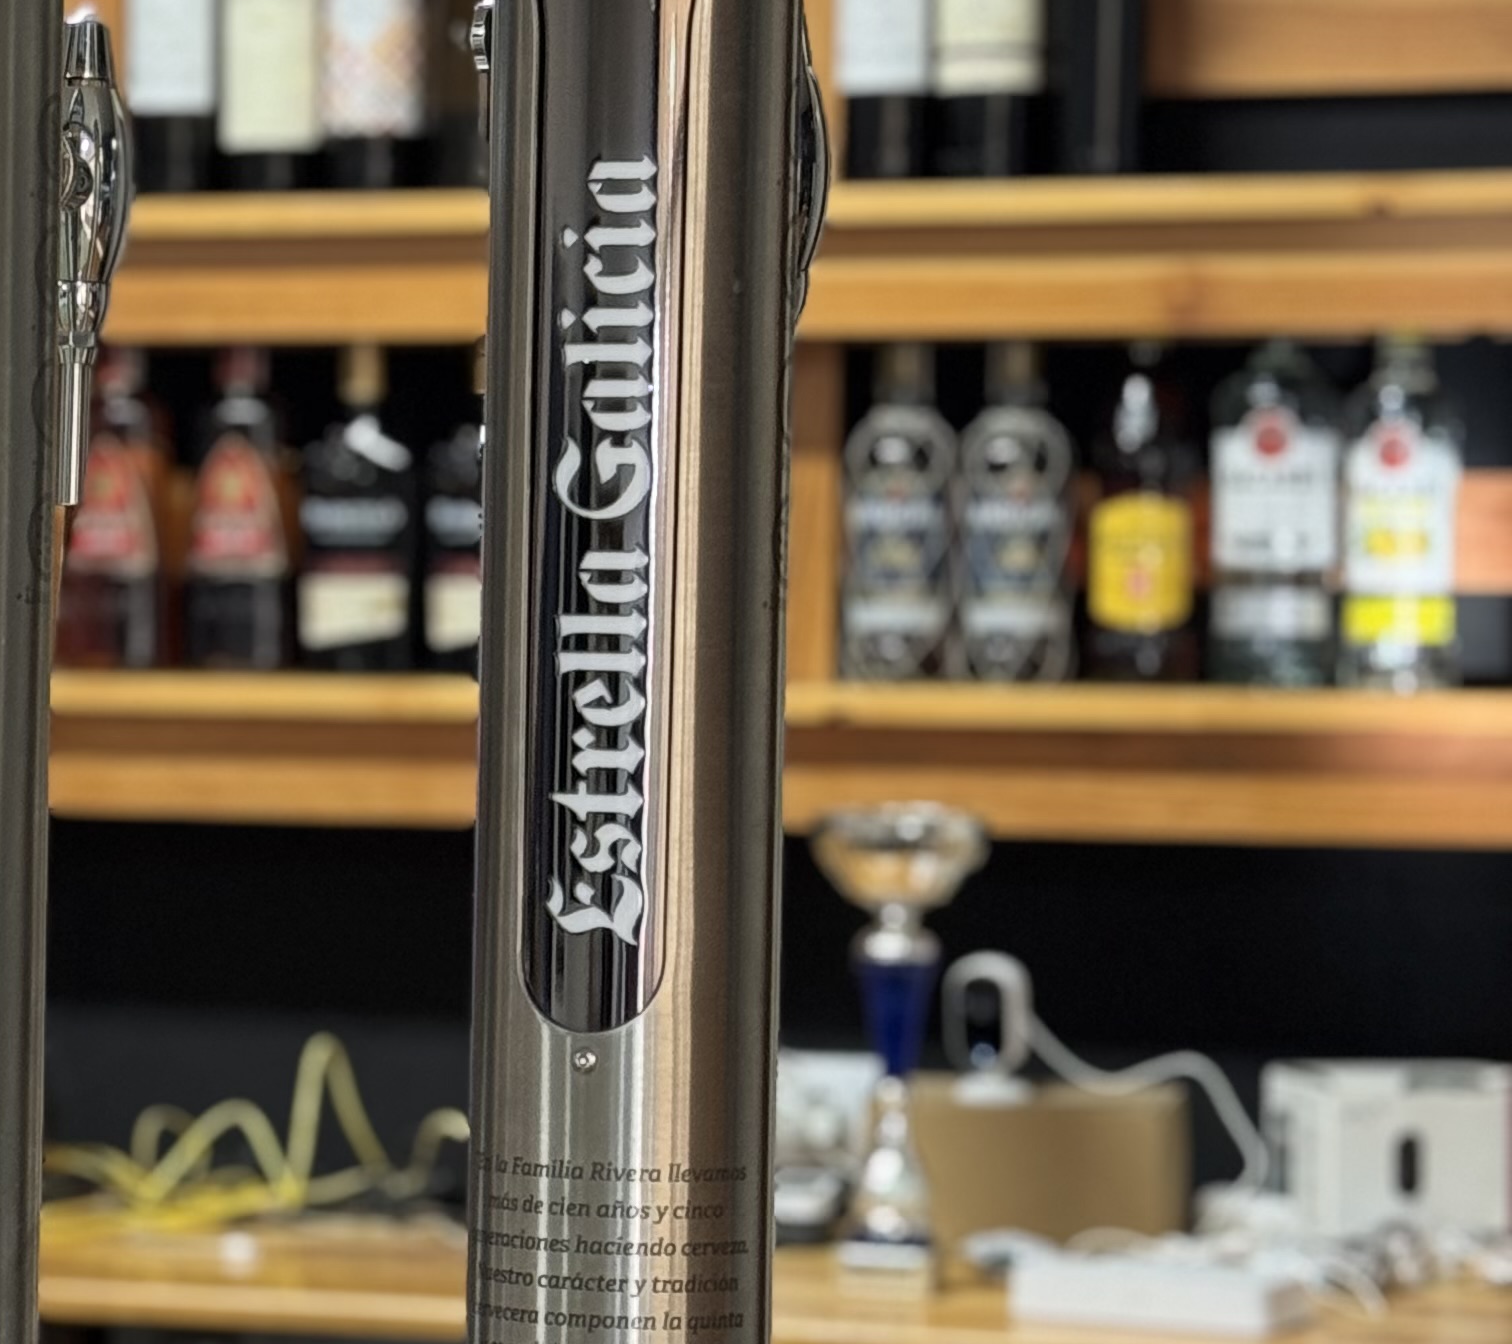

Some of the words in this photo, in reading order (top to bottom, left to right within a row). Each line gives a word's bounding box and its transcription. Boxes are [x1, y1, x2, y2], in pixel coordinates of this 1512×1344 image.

[552, 154, 657, 519] Galicia
[546, 543, 650, 946] Estrella
[512, 1157, 583, 1180] Familia
[591, 1161, 661, 1183] Rivera
[667, 1163, 747, 1184] llevamos
[522, 1194, 543, 1215] de
[549, 1196, 588, 1218] cien
[596, 1197, 650, 1220] años
[656, 1204, 670, 1224] y
[673, 1200, 724, 1220] cinco
[577, 1235, 676, 1257] haciendo
[537, 1272, 629, 1294] carácter
[631, 1278, 647, 1297] y
[651, 1274, 739, 1294] tradición
[544, 1311, 656, 1333] componen
[662, 1311, 682, 1331] la
[687, 1312, 744, 1335] quinta
